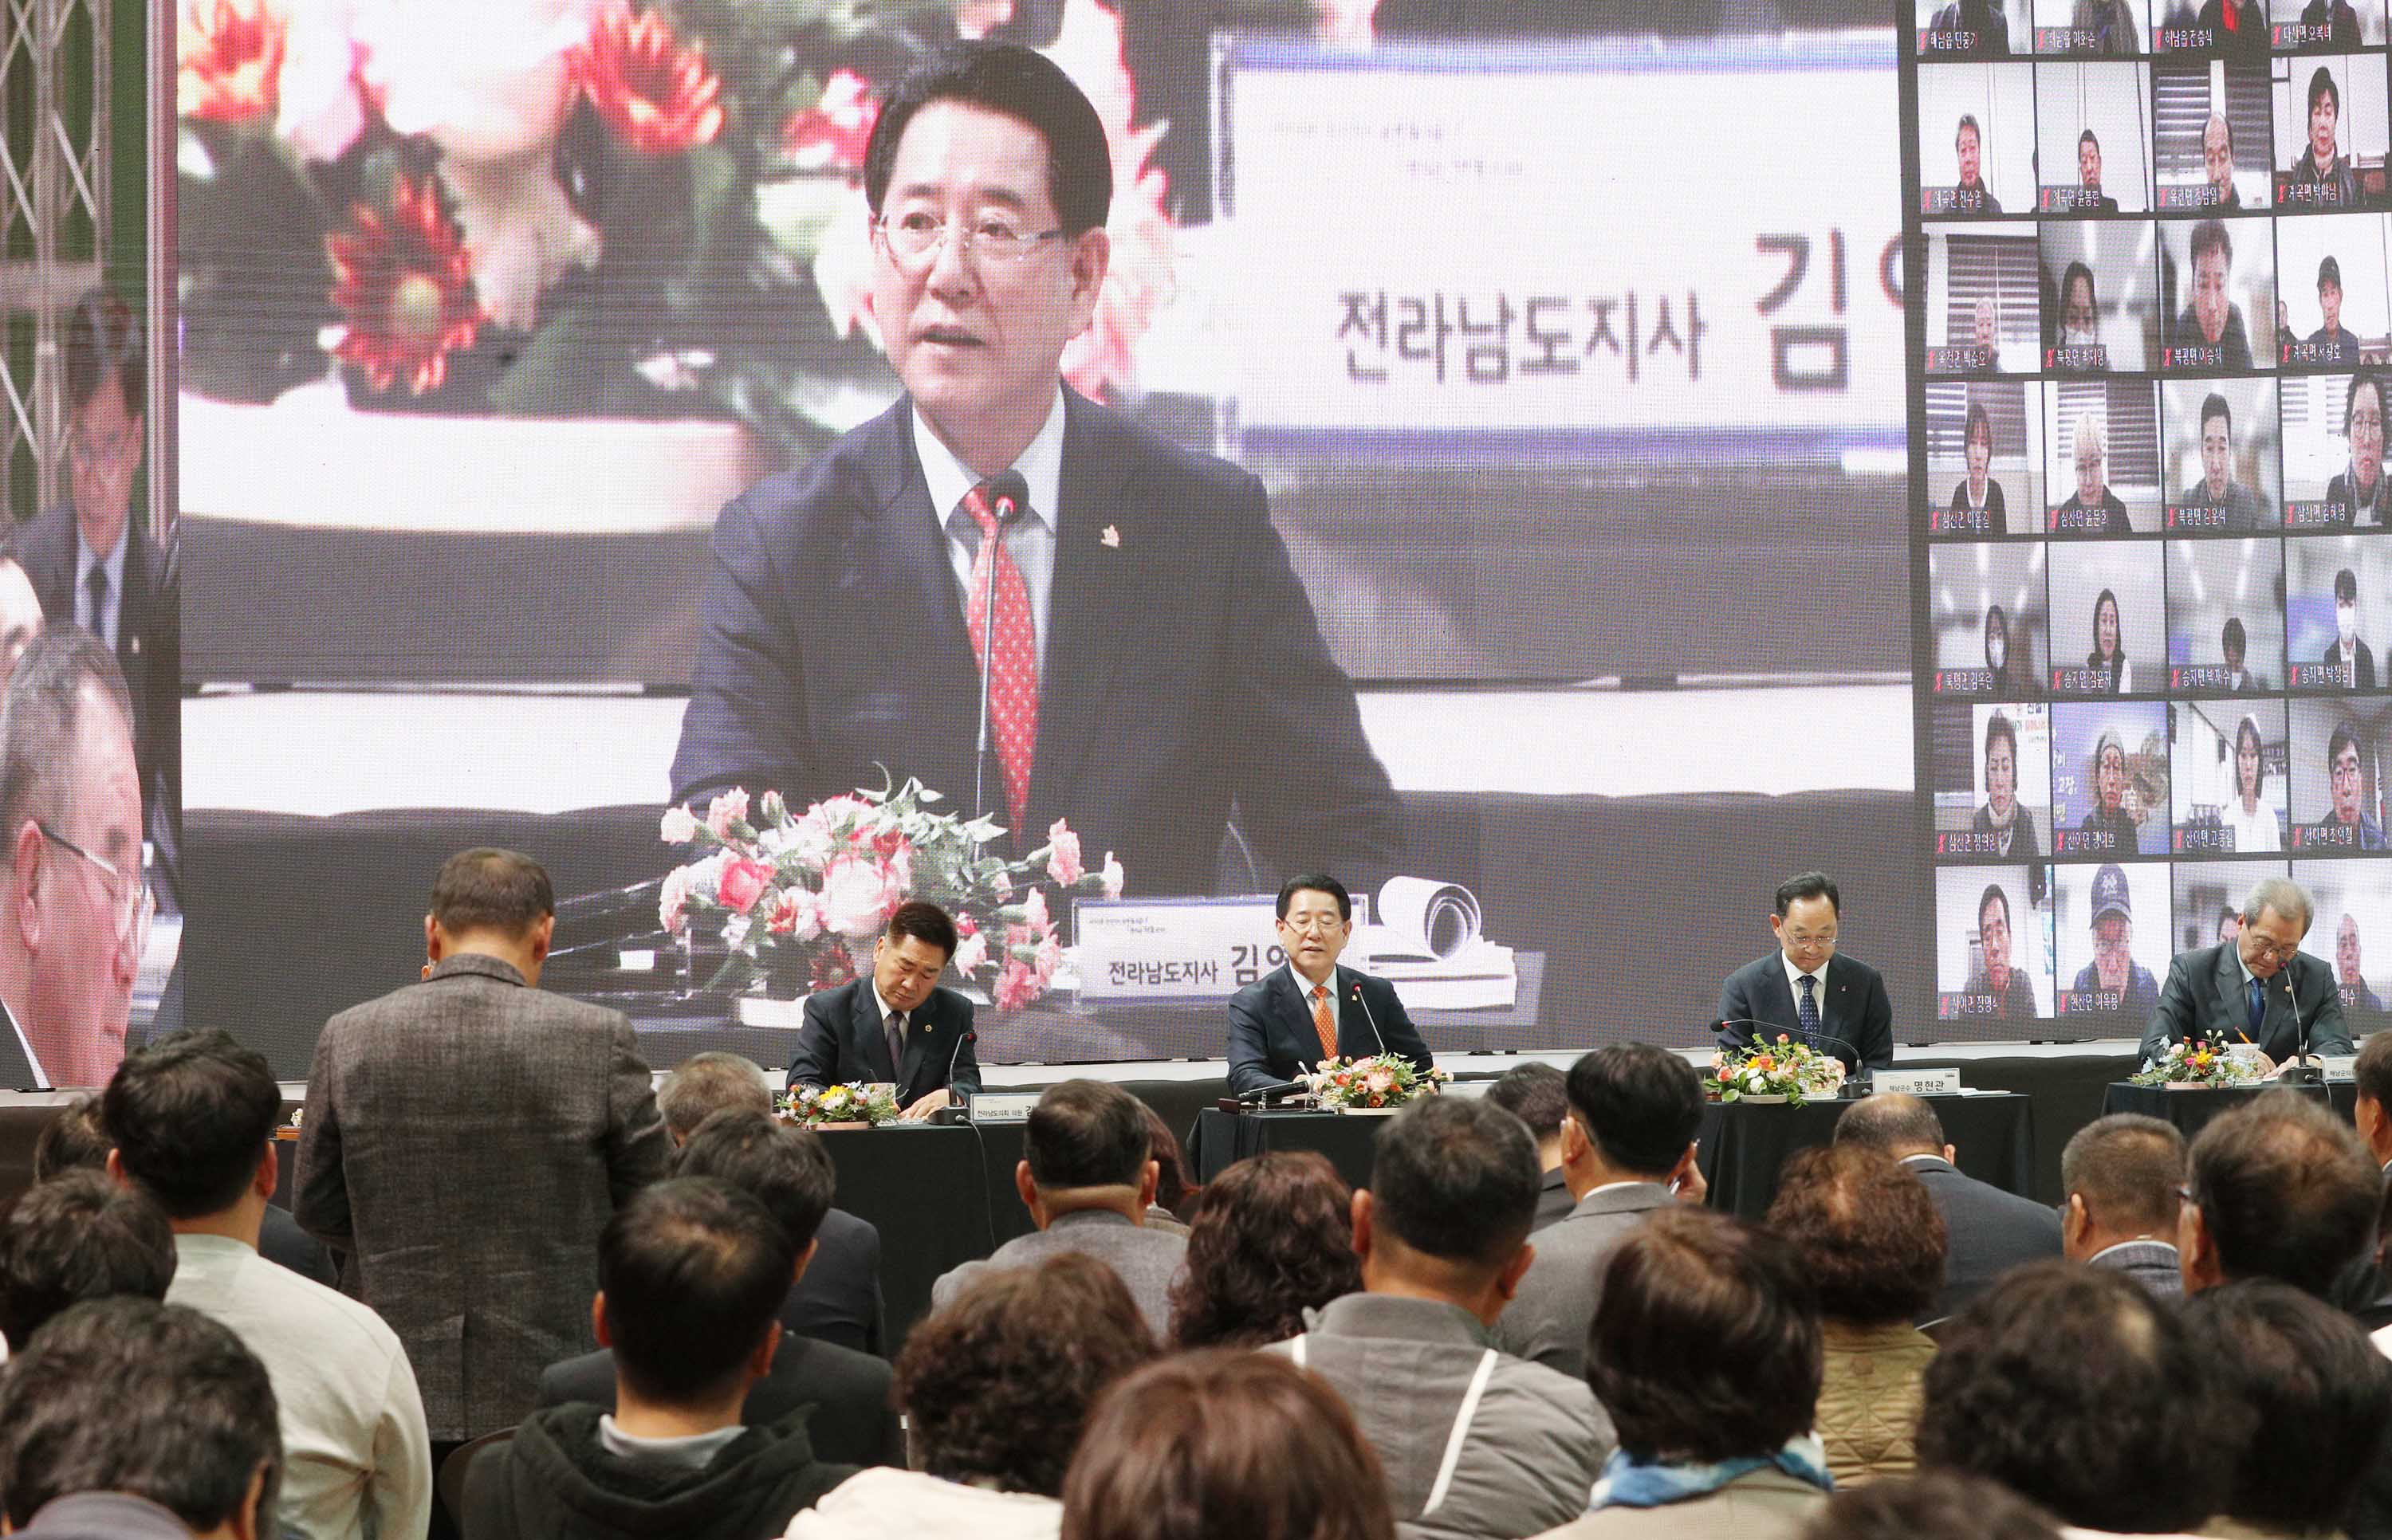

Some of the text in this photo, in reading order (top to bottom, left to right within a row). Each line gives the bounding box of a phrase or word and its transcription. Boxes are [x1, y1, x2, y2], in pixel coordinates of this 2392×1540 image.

[1930, 31, 1953, 49] 해남읍
[2165, 29, 2188, 48] 해남읍
[1338, 290, 1705, 383] 전라남도지사
[1108, 960, 1218, 985] 전라남도지사
[1914, 1079, 1945, 1092] 명현관
